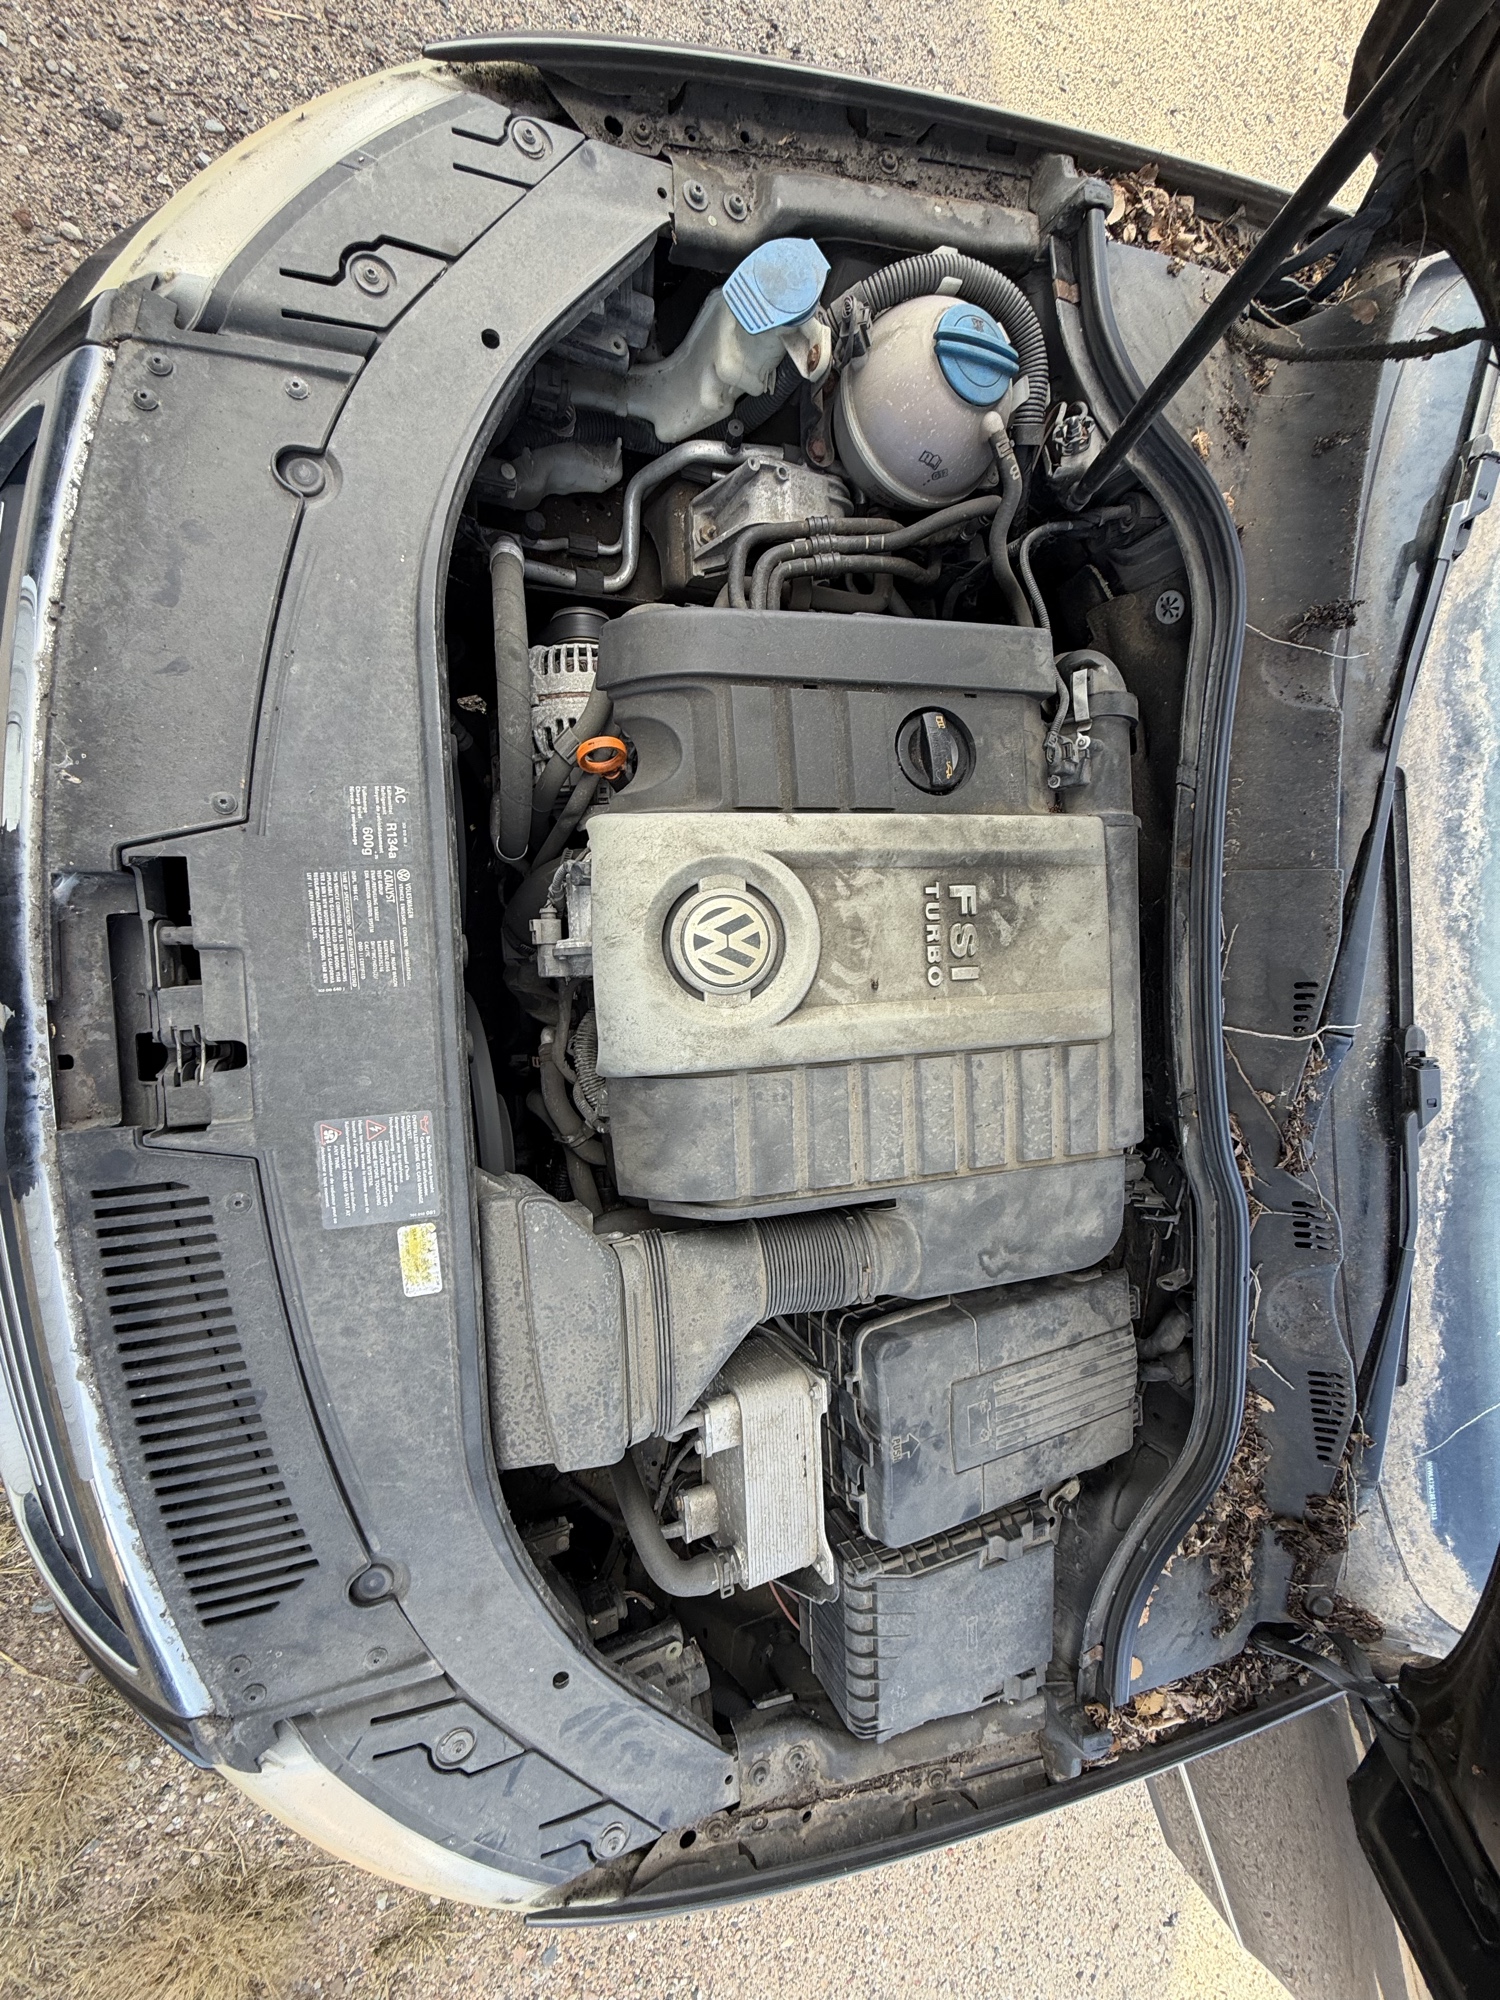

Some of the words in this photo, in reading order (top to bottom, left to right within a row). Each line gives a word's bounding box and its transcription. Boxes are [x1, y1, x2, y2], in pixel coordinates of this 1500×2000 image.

[394, 786, 406, 804] AC
[362, 827, 374, 856] 600g
[386, 823, 398, 858] R134a
[384, 870, 395, 903] CATALYST
[405, 883, 414, 918] VOLKSWAGEN
[925, 881, 943, 987] TURBO
[949, 885, 980, 980] FSI
[348, 938, 356, 968] ADJUSTMENTS
[892, 1438, 902, 1462] PUSH
